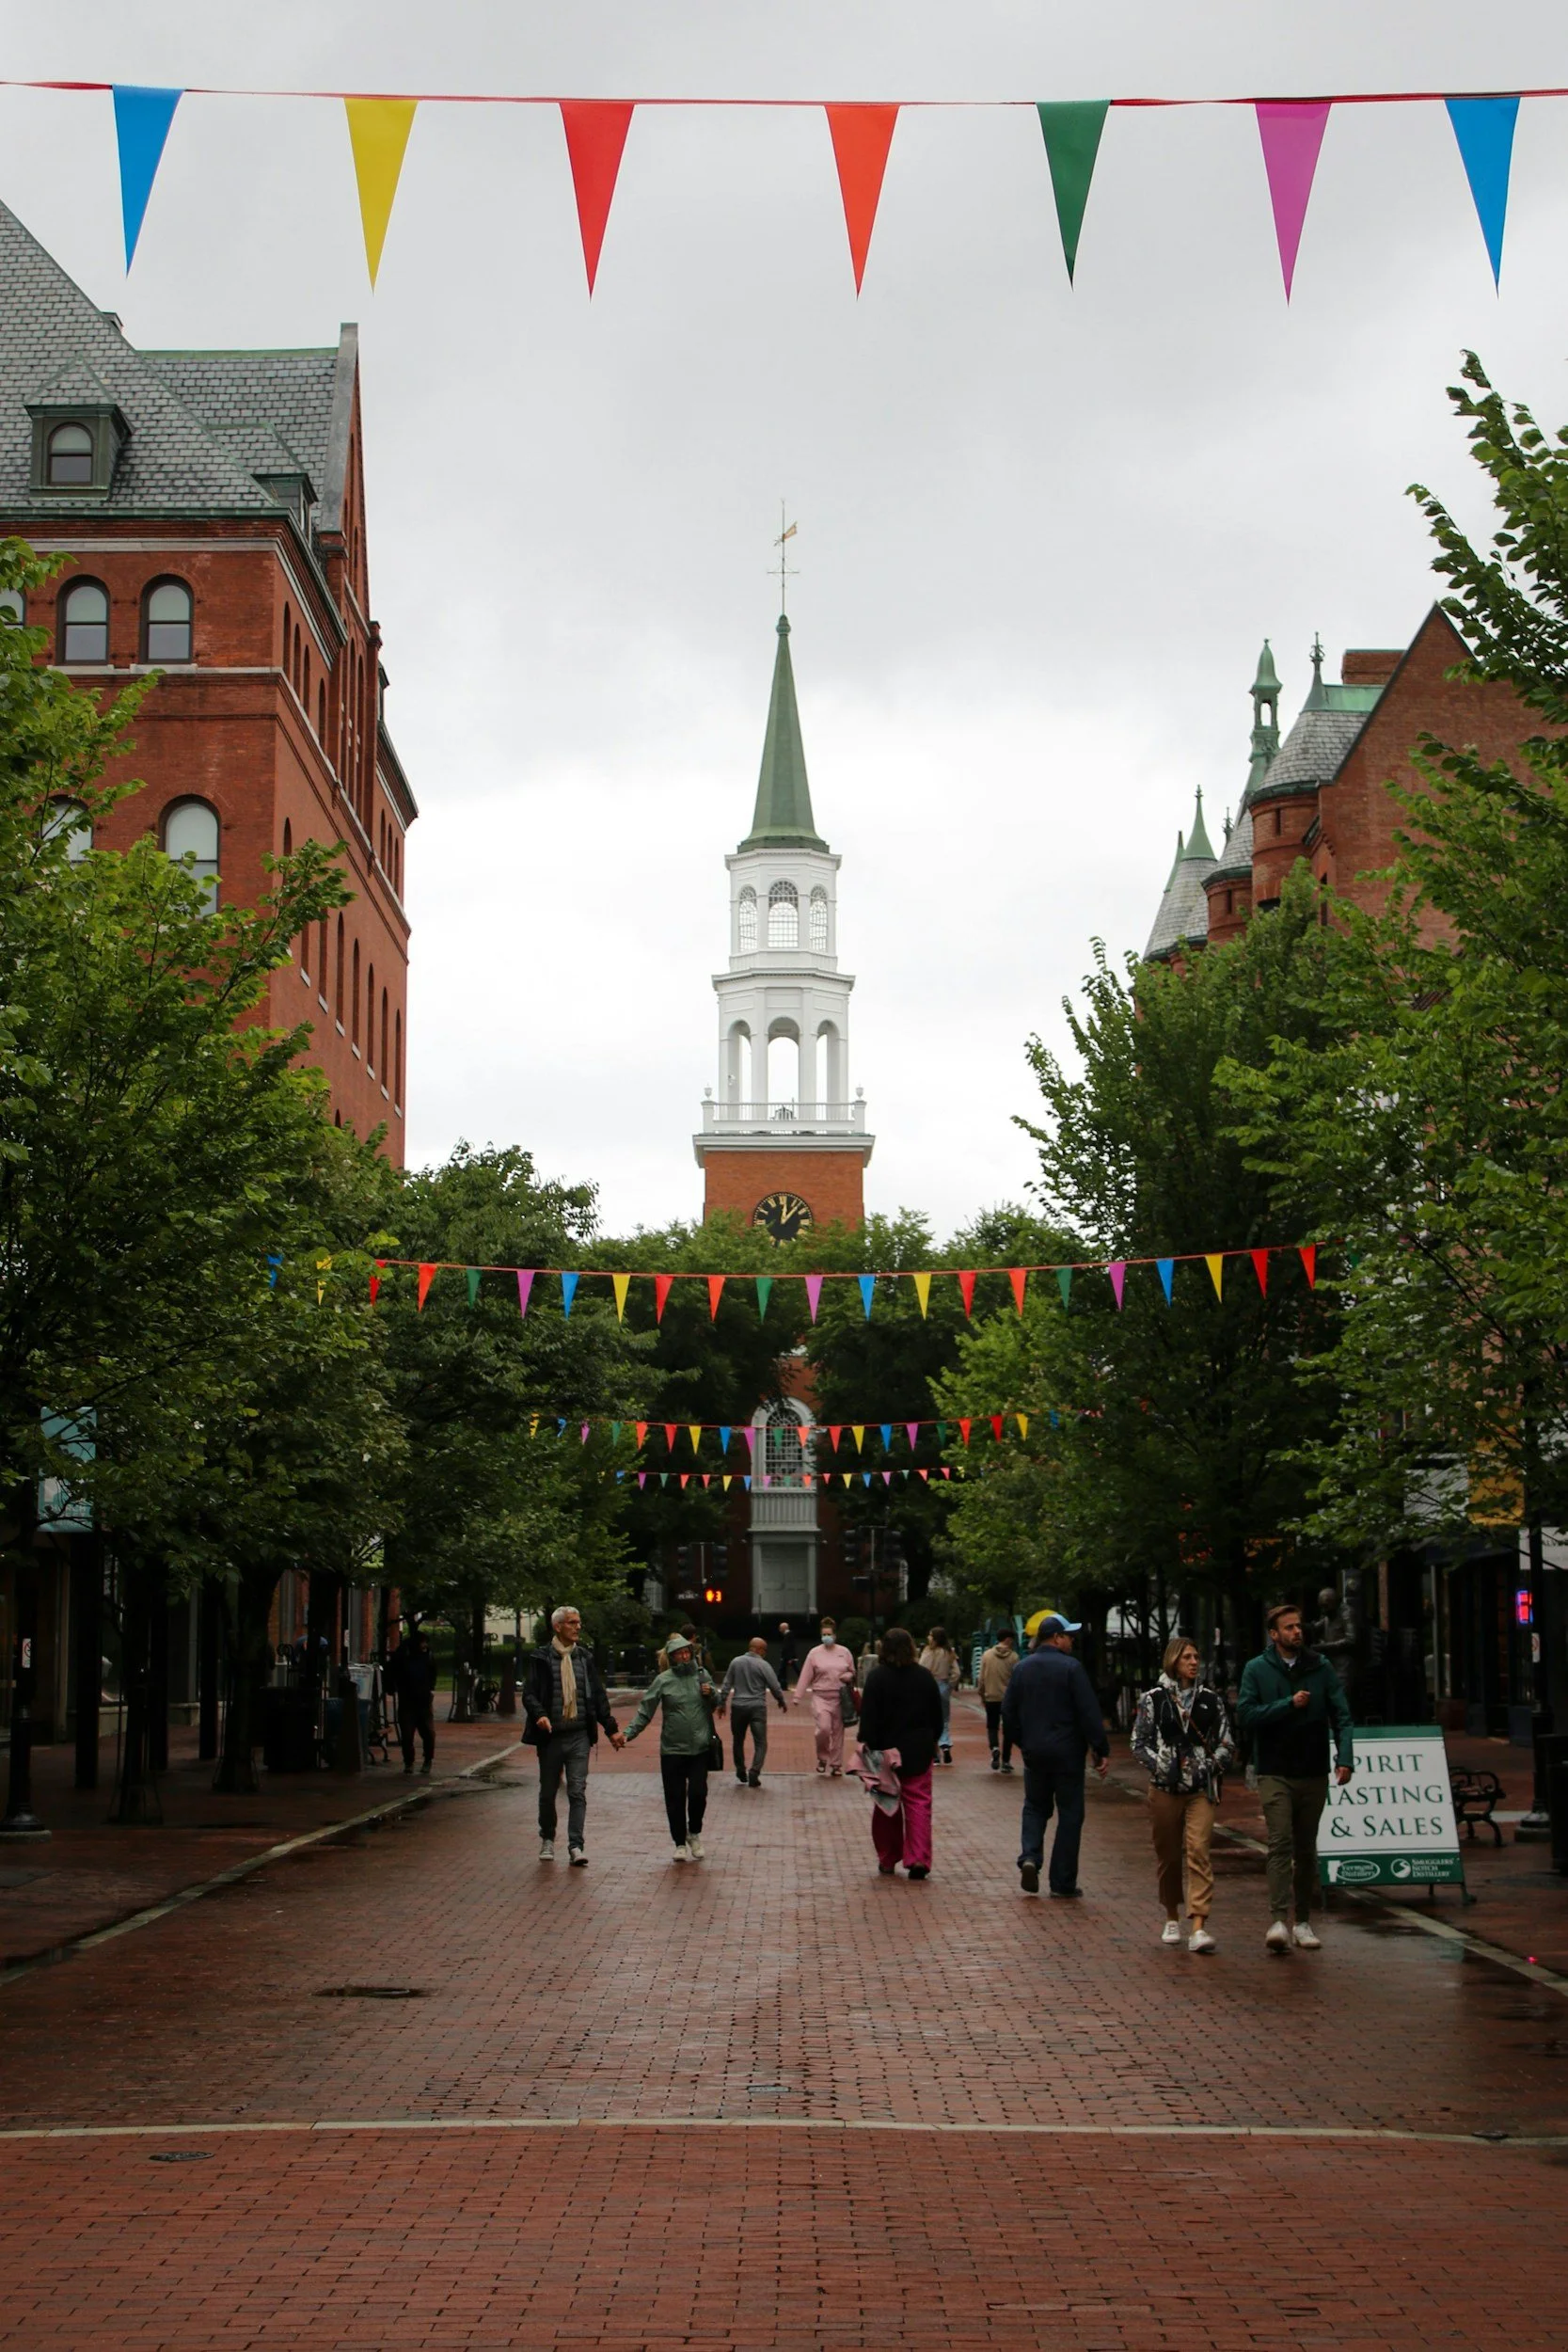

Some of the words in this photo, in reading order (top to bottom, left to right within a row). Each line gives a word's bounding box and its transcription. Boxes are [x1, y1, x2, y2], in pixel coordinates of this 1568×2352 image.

[1333, 1754, 1422, 1773] PIRIT
[1325, 1785, 1443, 1805] TASTING
[1331, 1817, 1354, 1837] &
[1363, 1815, 1442, 1836] SALES
[1412, 1869, 1449, 1878] DISTILLERY
